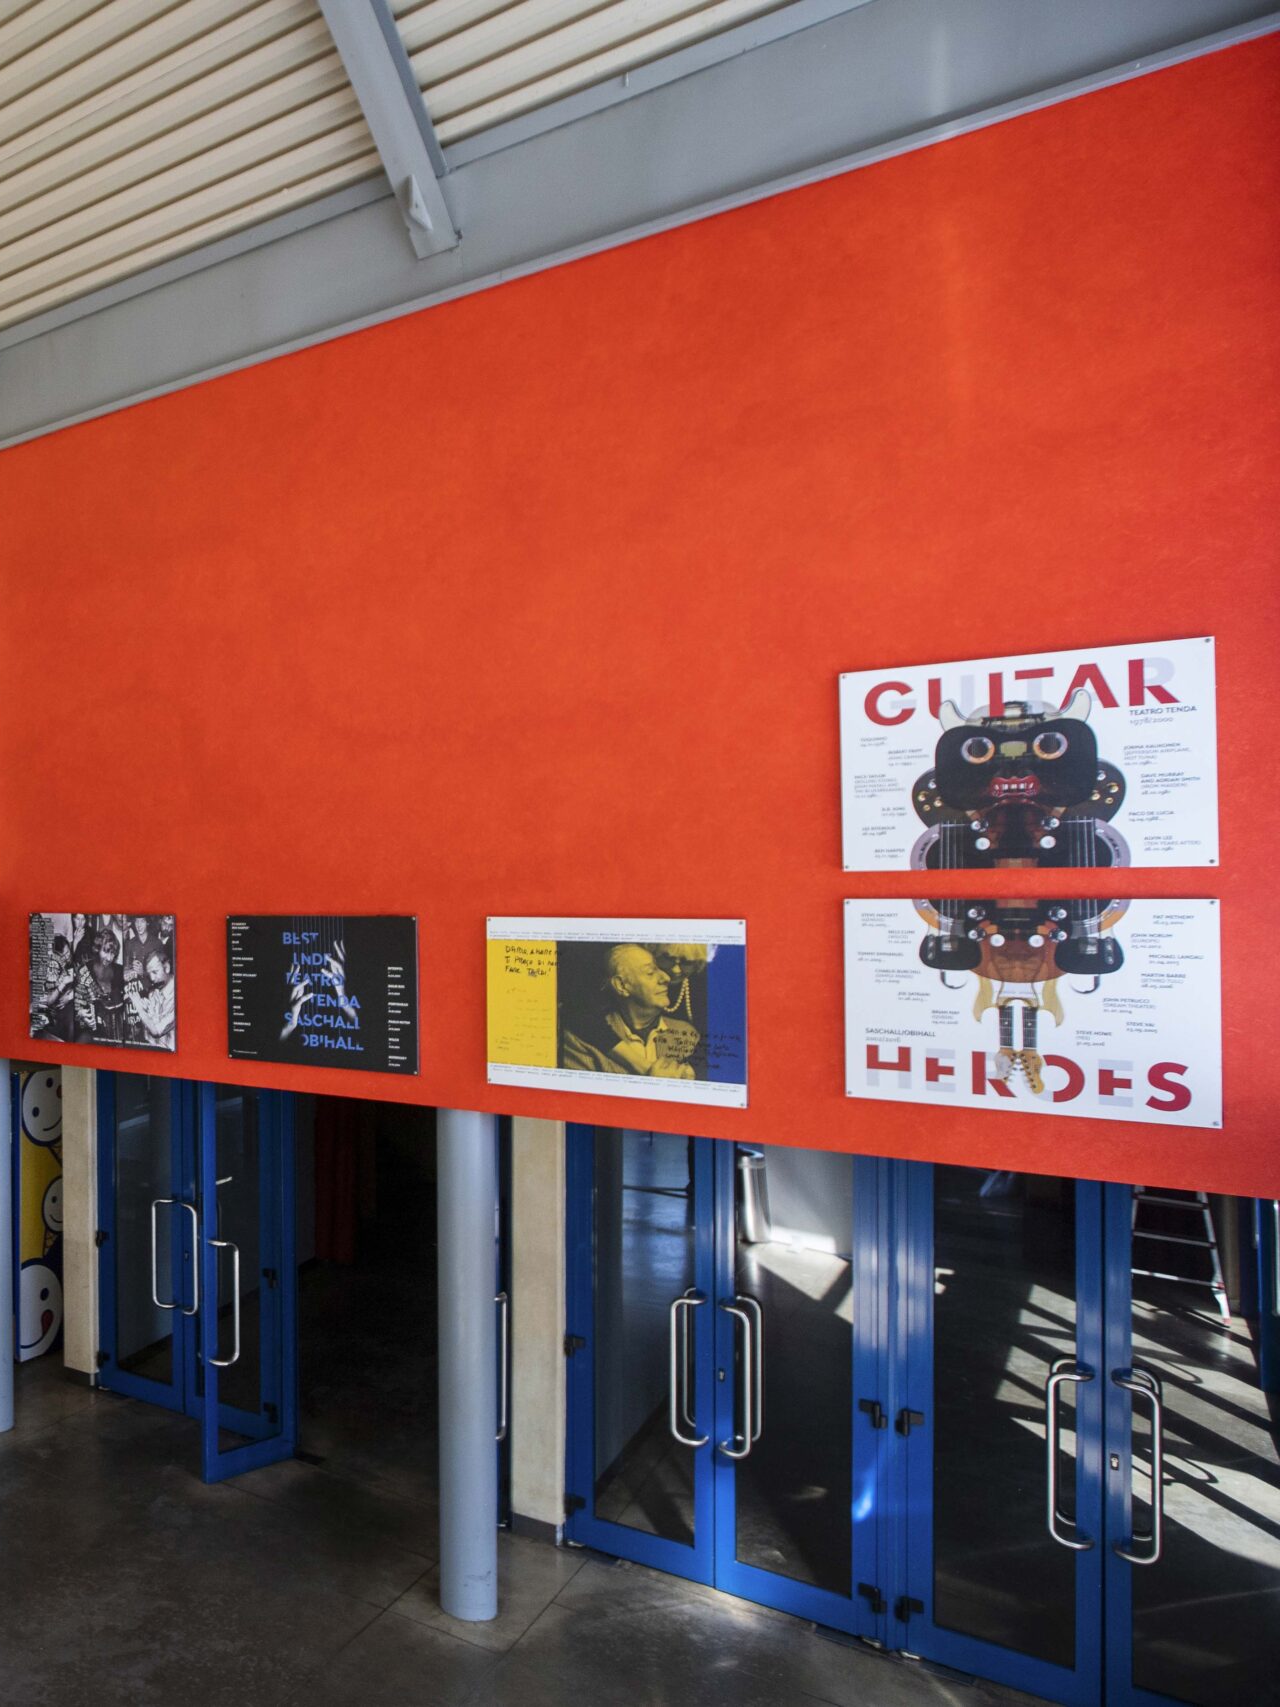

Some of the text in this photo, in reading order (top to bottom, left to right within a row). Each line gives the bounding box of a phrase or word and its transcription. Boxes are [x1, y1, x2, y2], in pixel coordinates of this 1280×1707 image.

[864, 656, 1180, 727] GUITAR
[1129, 704, 1197, 717] TEATRO TENDA
[283, 931, 319, 945] BEST
[286, 972, 345, 987] TEATRO
[310, 993, 361, 1009] TENDA
[865, 1028, 936, 1038] SASCHALL/OBIHALL
[866, 1043, 1193, 1113] HEROES
